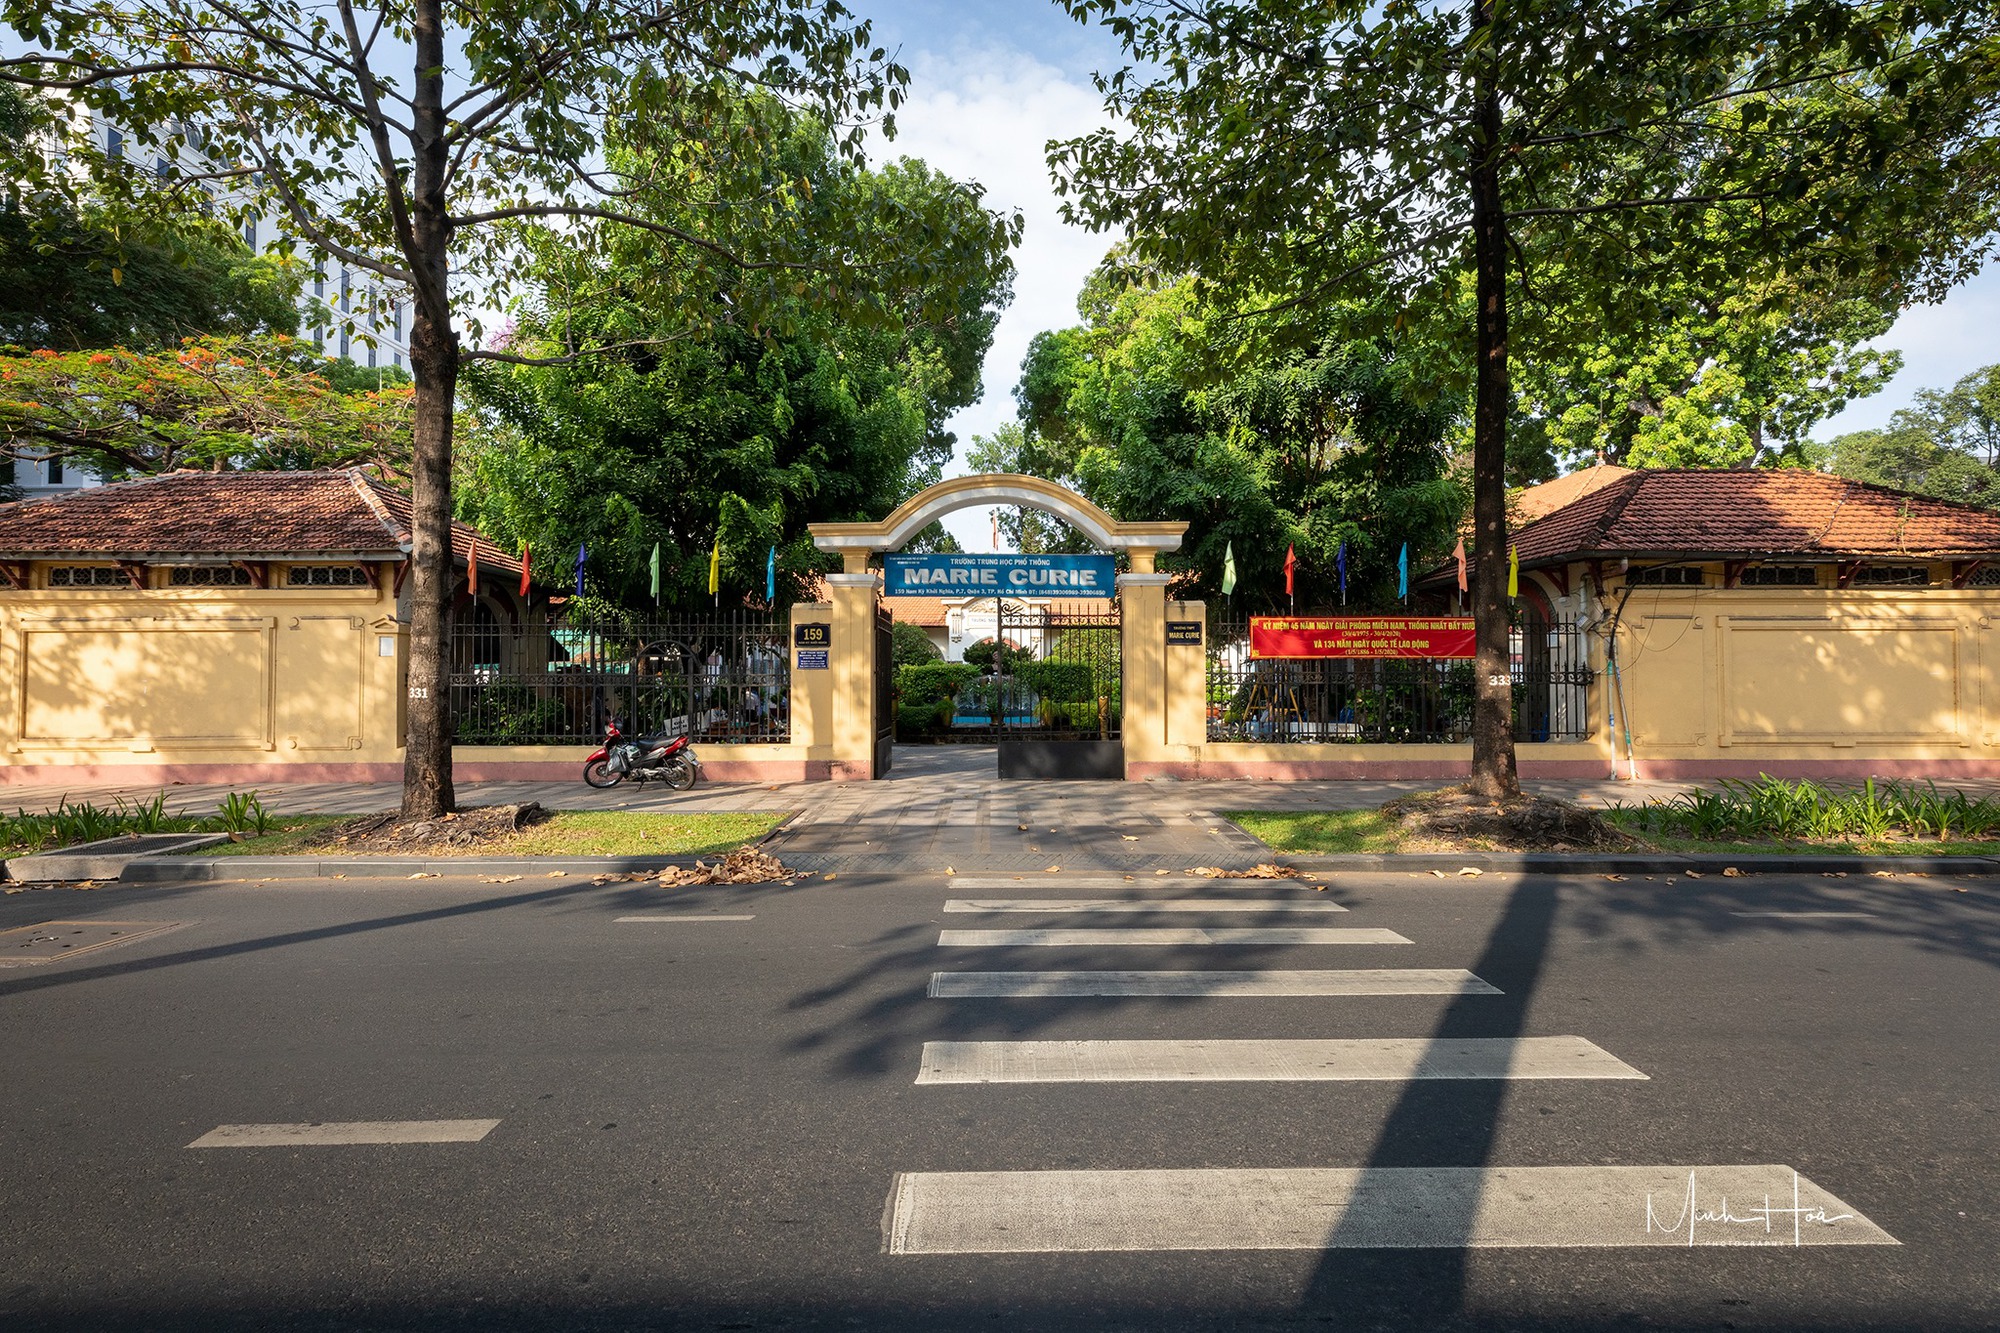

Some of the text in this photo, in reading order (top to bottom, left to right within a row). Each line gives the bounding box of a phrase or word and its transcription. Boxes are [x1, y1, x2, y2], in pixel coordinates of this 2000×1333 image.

[904, 568, 1098, 586] MARIE CURIE
[1290, 622, 1298, 630] 45
[1316, 620, 1333, 630] NGÀY
[804, 628, 823, 640] 159
[1314, 639, 1323, 648] VÀ
[1353, 639, 1370, 648] NGÀY
[1398, 640, 1410, 648] LAO
[1489, 675, 1511, 686] 333
[409, 687, 428, 698] 331
